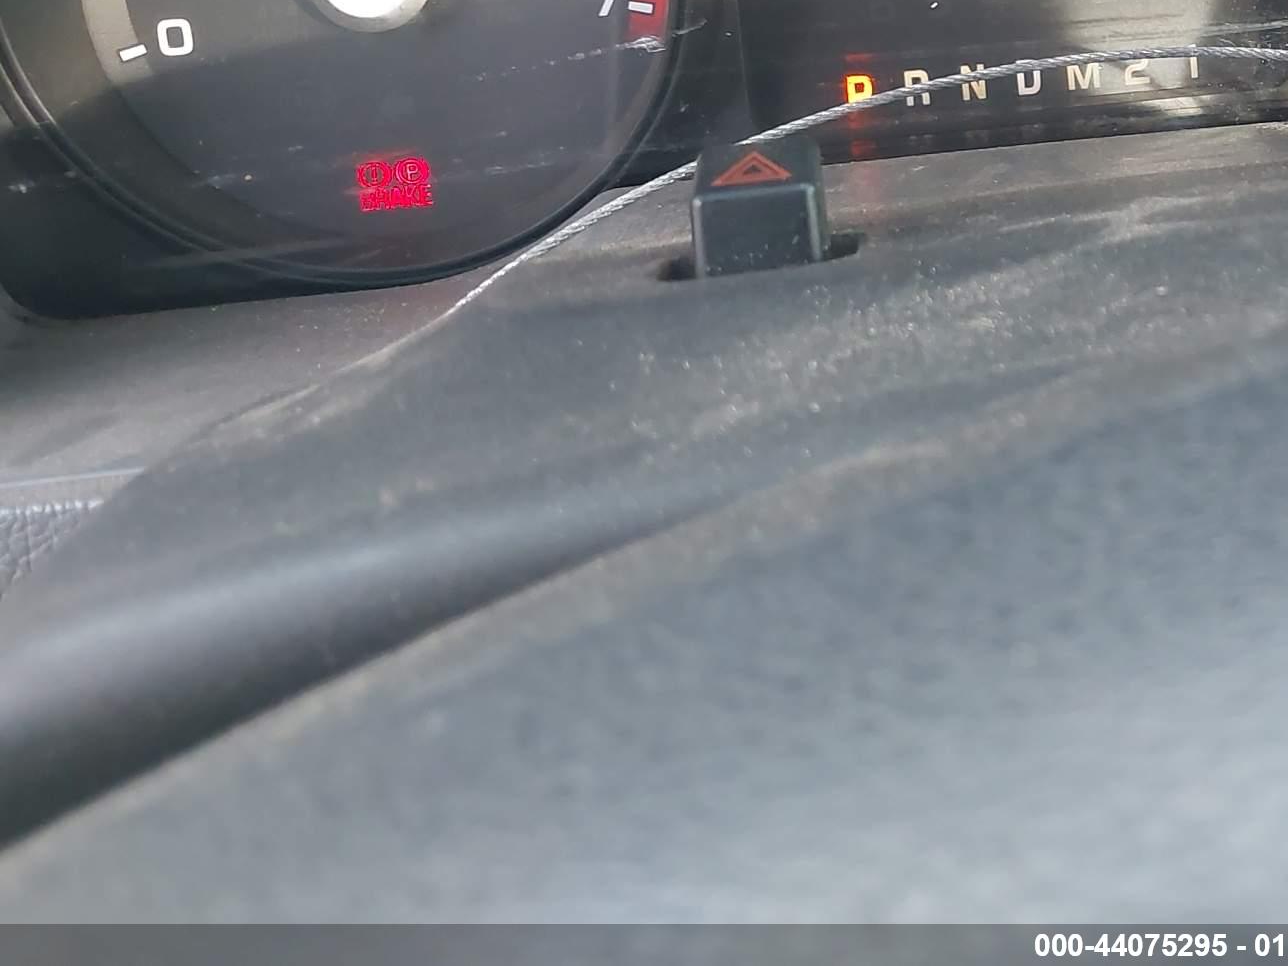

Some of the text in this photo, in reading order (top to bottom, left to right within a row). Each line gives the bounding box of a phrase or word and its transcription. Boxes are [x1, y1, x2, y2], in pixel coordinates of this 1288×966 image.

[157, 18, 195, 56] 0
[846, 75, 873, 104] P
[904, 69, 931, 106] R
[960, 63, 987, 101] N
[1016, 68, 1042, 96] D
[1066, 61, 1101, 91] M
[1125, 57, 1150, 86] 2
